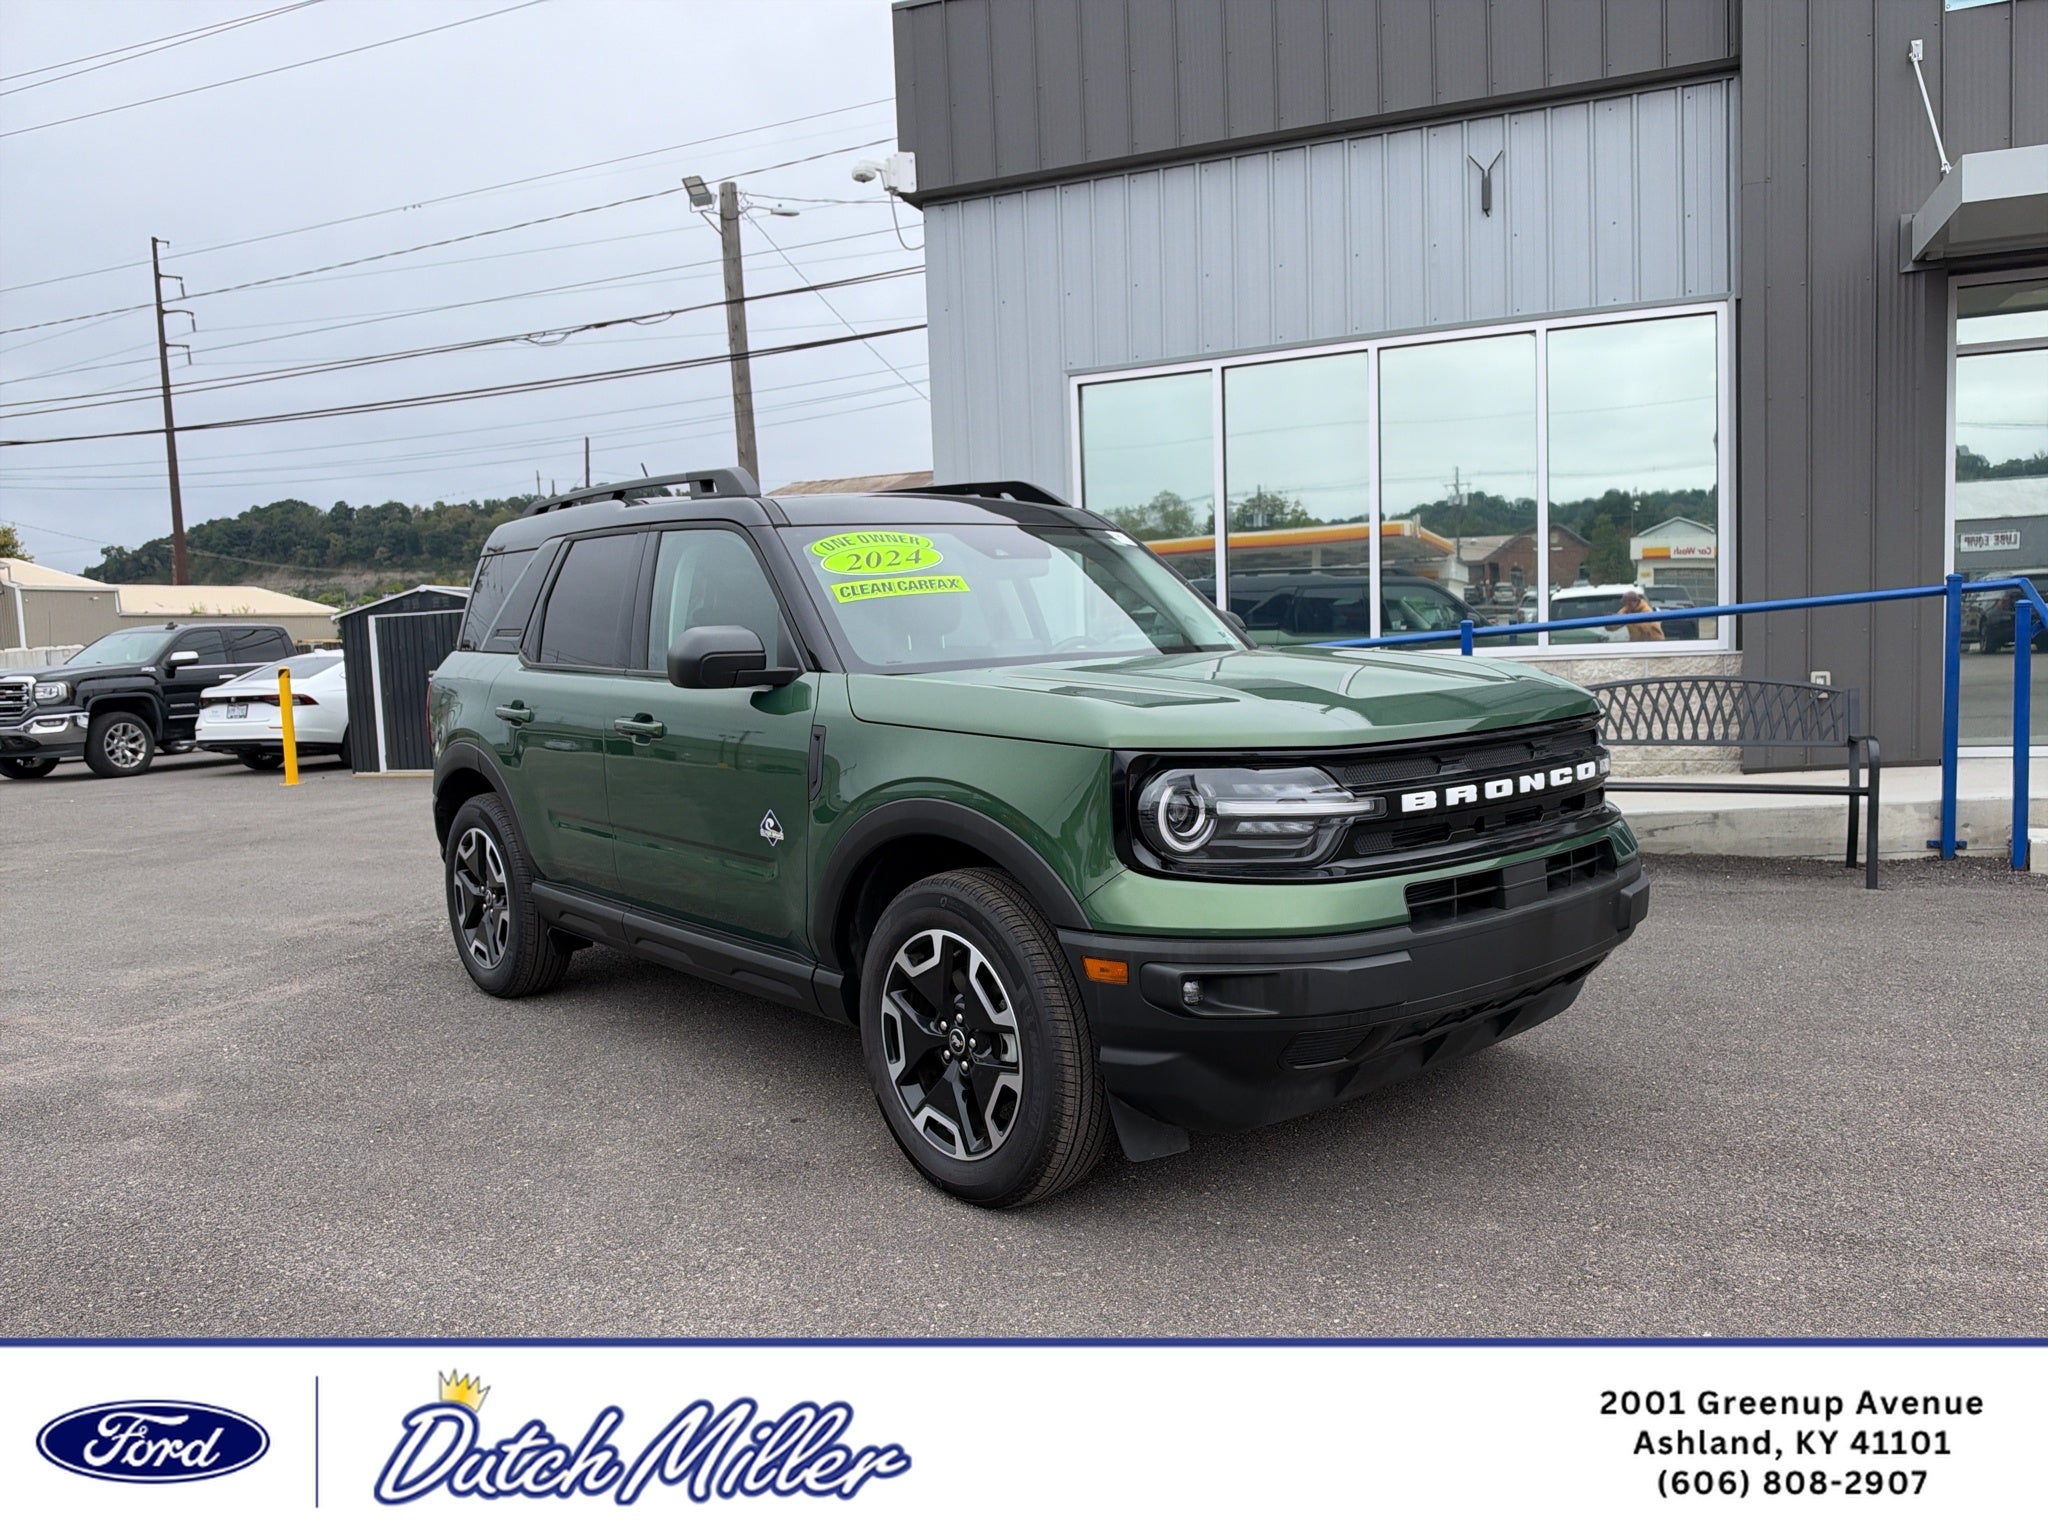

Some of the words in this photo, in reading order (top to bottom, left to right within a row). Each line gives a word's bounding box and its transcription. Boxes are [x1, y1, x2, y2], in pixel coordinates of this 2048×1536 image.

[819, 535, 857, 552] ONE
[857, 533, 920, 546] OWNER
[846, 549, 923, 571] 2024
[839, 581, 894, 598] CLEAN
[897, 578, 959, 592] CARFAX
[1401, 761, 1596, 813] BRONCO
